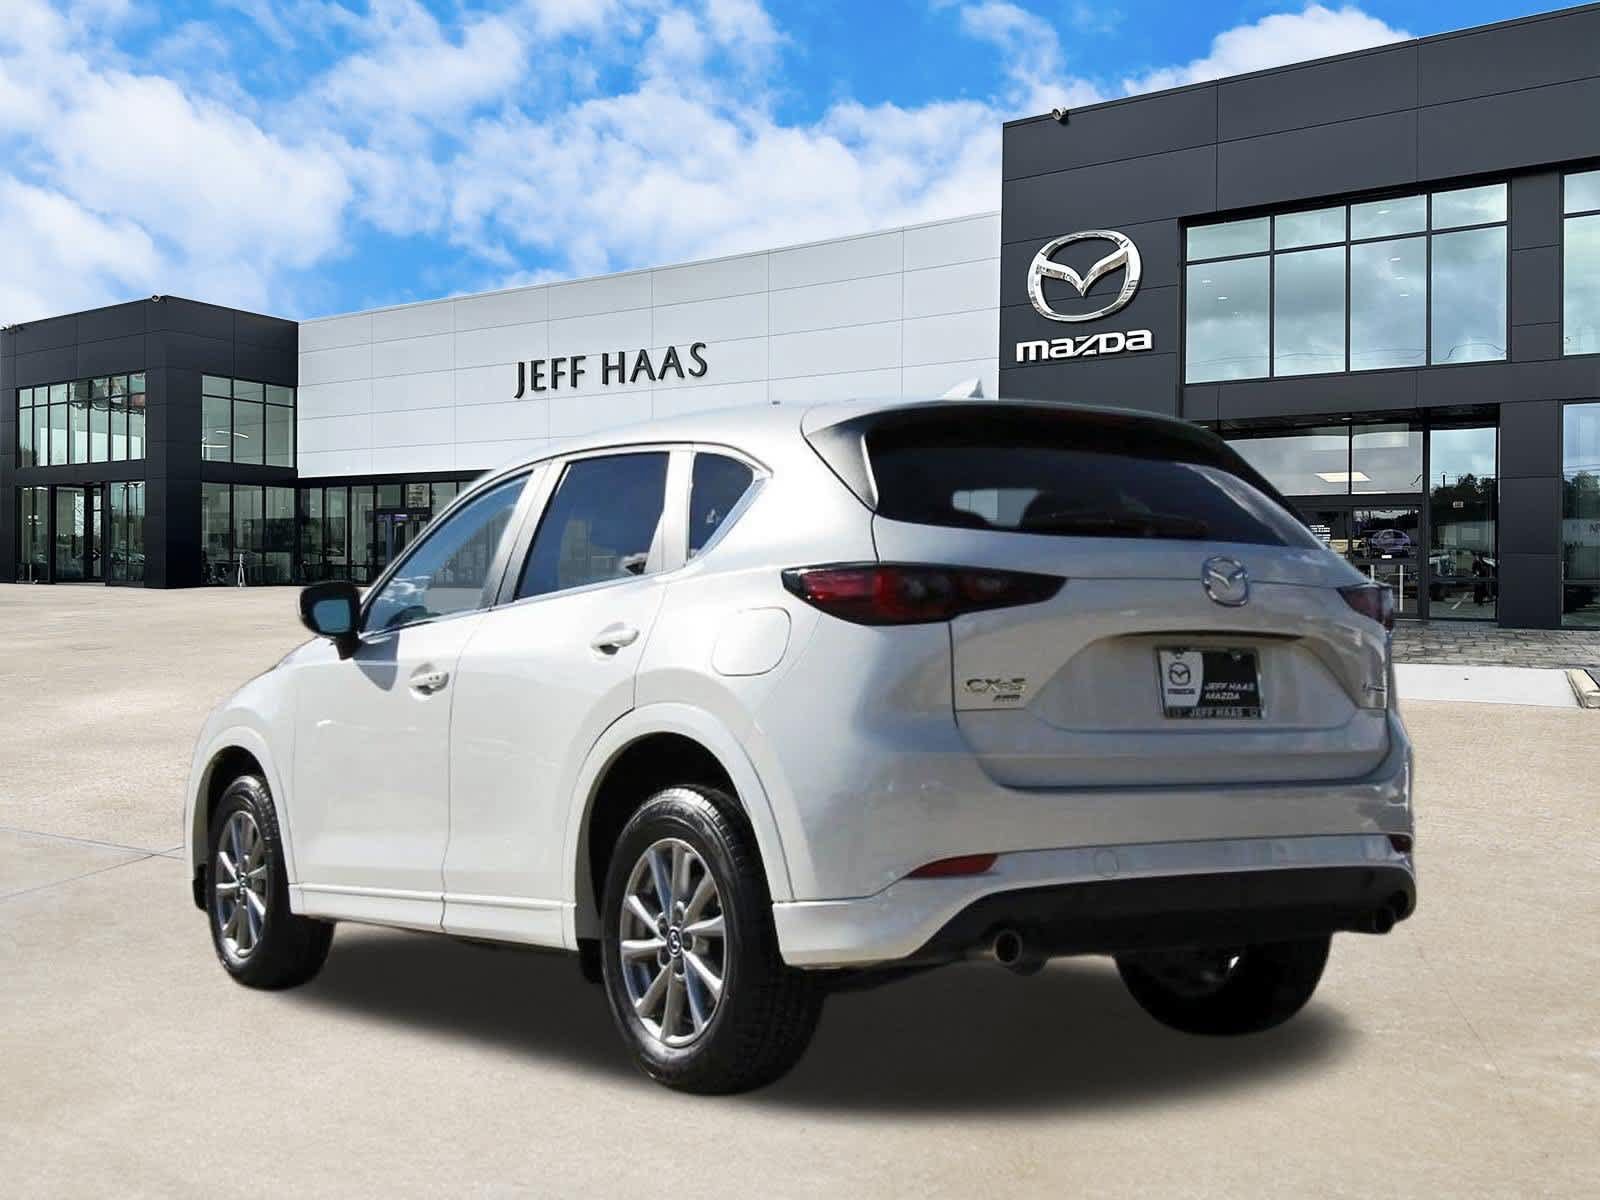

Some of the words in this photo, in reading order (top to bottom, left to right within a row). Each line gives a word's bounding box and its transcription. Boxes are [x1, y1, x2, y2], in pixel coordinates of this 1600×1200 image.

[513, 355, 586, 399] JEFF
[601, 342, 708, 386] HAAS
[1205, 682, 1227, 691] JEFF
[1229, 682, 1255, 691] HAAS
[1205, 692, 1240, 700] MAZDA
[1190, 707, 1214, 718] JEFF
[1216, 706, 1244, 717] HAAS
